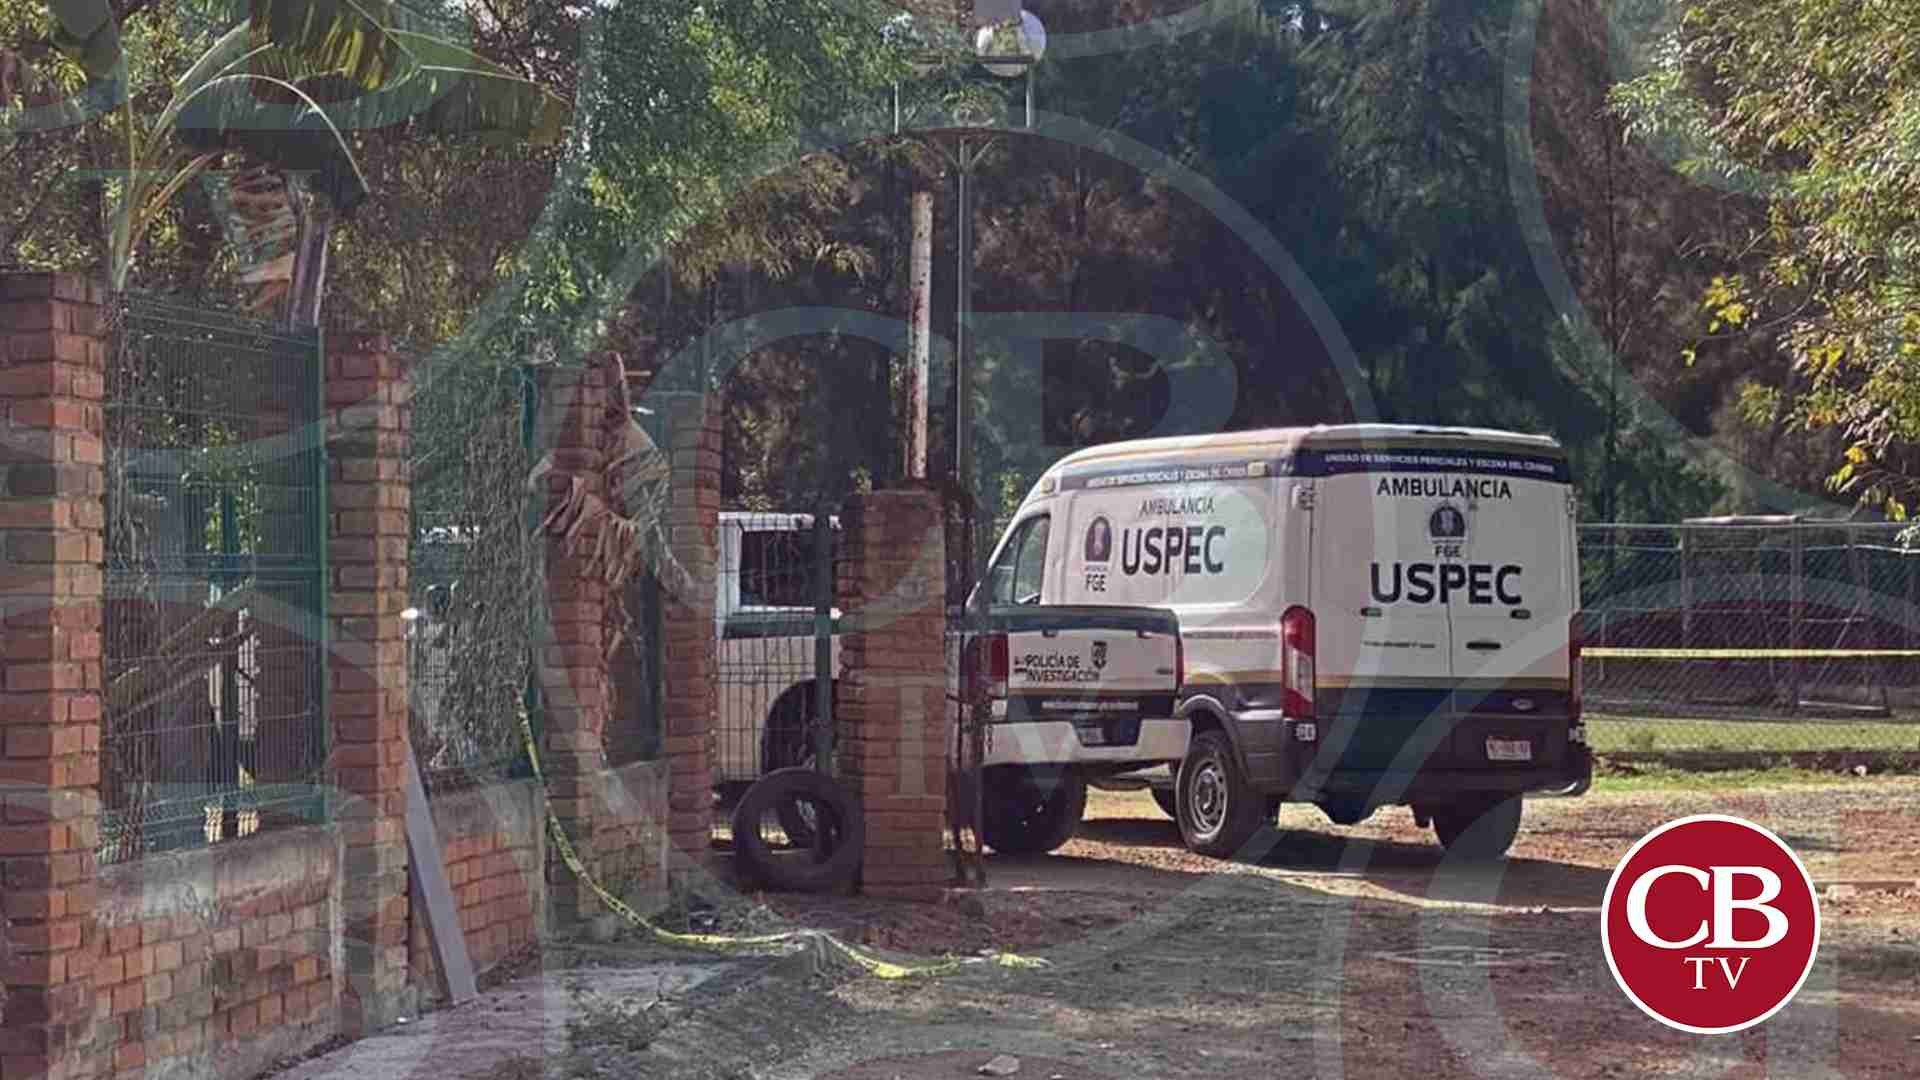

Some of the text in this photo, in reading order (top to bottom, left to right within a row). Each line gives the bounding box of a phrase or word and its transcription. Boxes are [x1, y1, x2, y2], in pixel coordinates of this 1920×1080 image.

[1377, 477, 1512, 499] AMBULANCIA
[1139, 497, 1215, 517] AMBULANCIA
[1122, 526, 1226, 576] USPEC
[1370, 562, 1522, 605] USPEC
[1025, 651, 1080, 669] POLICÍA DE
